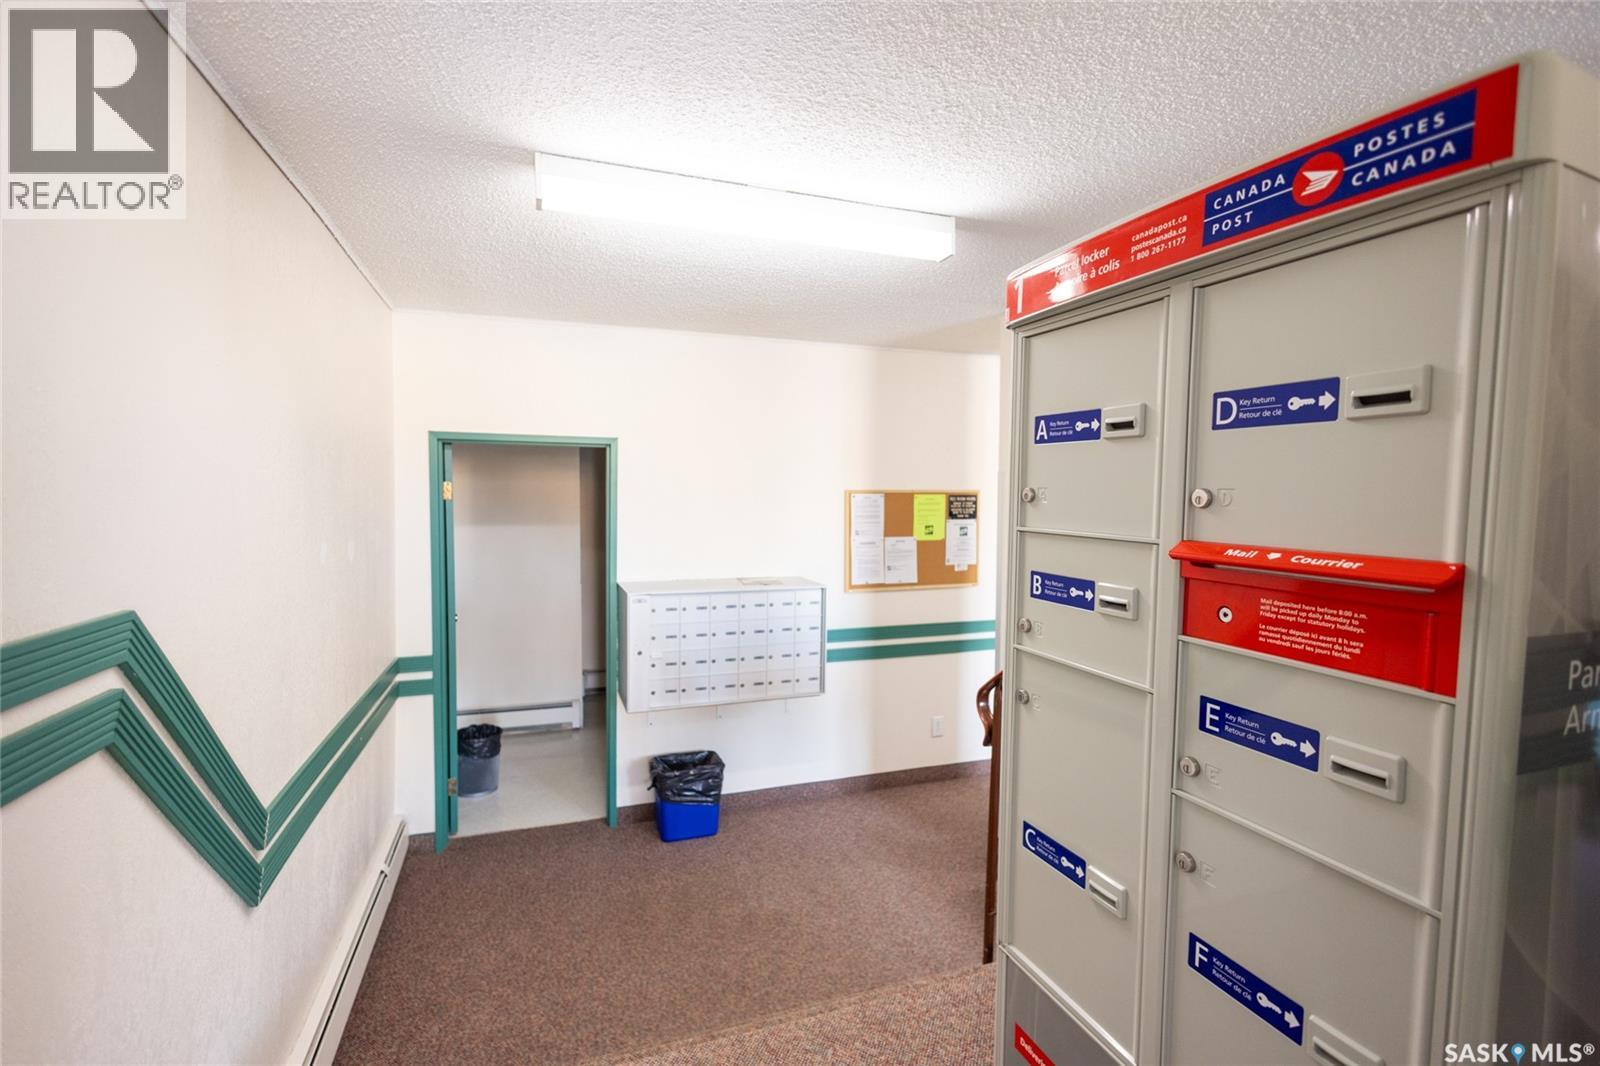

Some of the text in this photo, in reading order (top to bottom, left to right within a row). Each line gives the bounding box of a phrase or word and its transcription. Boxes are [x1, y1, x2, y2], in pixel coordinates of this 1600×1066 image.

[1353, 111, 1446, 158] POSTES
[1351, 141, 1457, 187] CANADA
[1213, 173, 1287, 210] CANADA
[1131, 214, 1188, 242] canadapost.ca
[1211, 210, 1254, 235] POST
[1131, 226, 1187, 254] postescanada.ca
[1136, 249, 1150, 260] 800
[1151, 235, 1186, 255] 267-1177
[1081, 246, 1110, 266] locker
[1090, 259, 1120, 279] à colis
[1216, 397, 1237, 425] D
[1240, 396, 1276, 407] Key Return
[1239, 411, 1261, 419] Retour
[1036, 420, 1048, 440] A
[1223, 548, 1364, 569] Mail Courrier
[1033, 574, 1042, 595] B
[1273, 600, 1301, 610] deposited
[1317, 606, 1338, 615] before
[1279, 608, 1298, 616] picked
[1307, 612, 1323, 620] daily
[1324, 615, 1350, 624] Monday
[1259, 611, 1277, 619] Friday
[1277, 614, 1296, 622] except
[1307, 619, 1336, 630] statutory
[1266, 625, 1288, 633] courrier
[1319, 634, 1337, 643] avant
[1266, 637, 1291, 648] vendredi
[1292, 642, 1305, 650] sauf
[1315, 647, 1330, 656] jours
[1343, 645, 1361, 654] lundi
[1205, 702, 1220, 732] E
[1225, 712, 1260, 729] Key Return
[1224, 725, 1246, 737] Retour
[1246, 733, 1255, 741] de
[1025, 829, 1036, 850] C
[1195, 941, 1209, 967] F
[1212, 968, 1233, 987] Retour
[1213, 957, 1246, 984] Key Return
